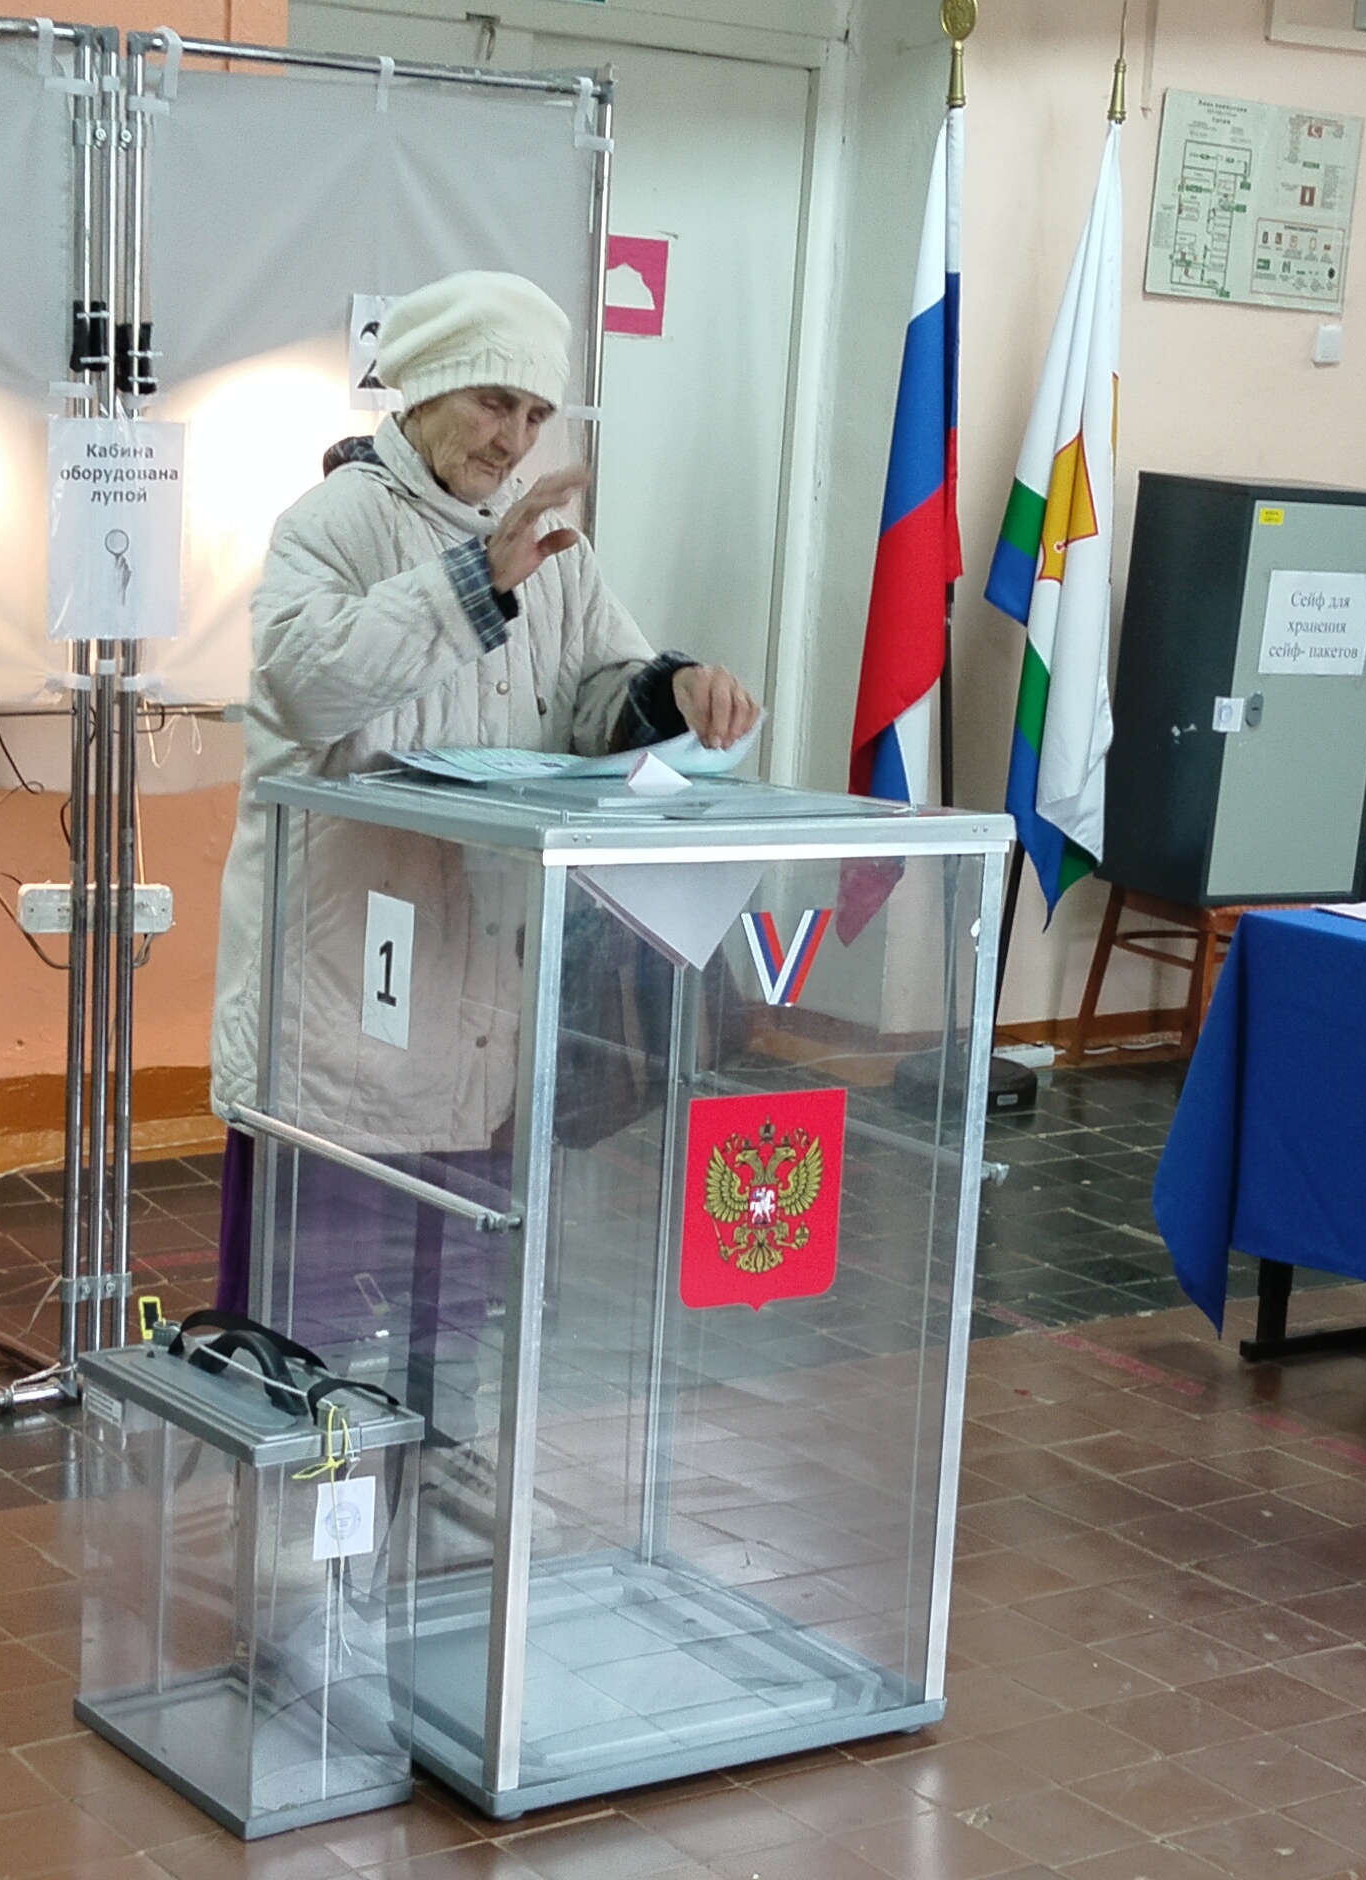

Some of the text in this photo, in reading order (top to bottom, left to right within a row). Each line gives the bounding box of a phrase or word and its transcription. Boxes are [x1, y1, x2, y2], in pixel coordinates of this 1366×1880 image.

[86, 443, 154, 459] Кабина
[60, 464, 179, 484] оборудована
[90, 486, 147, 506] лупой
[1290, 590, 1351, 612] Сейф для
[1287, 621, 1347, 637] хранения
[1268, 641, 1359, 662] сейф- пакетов
[376, 940, 397, 1007] 1
